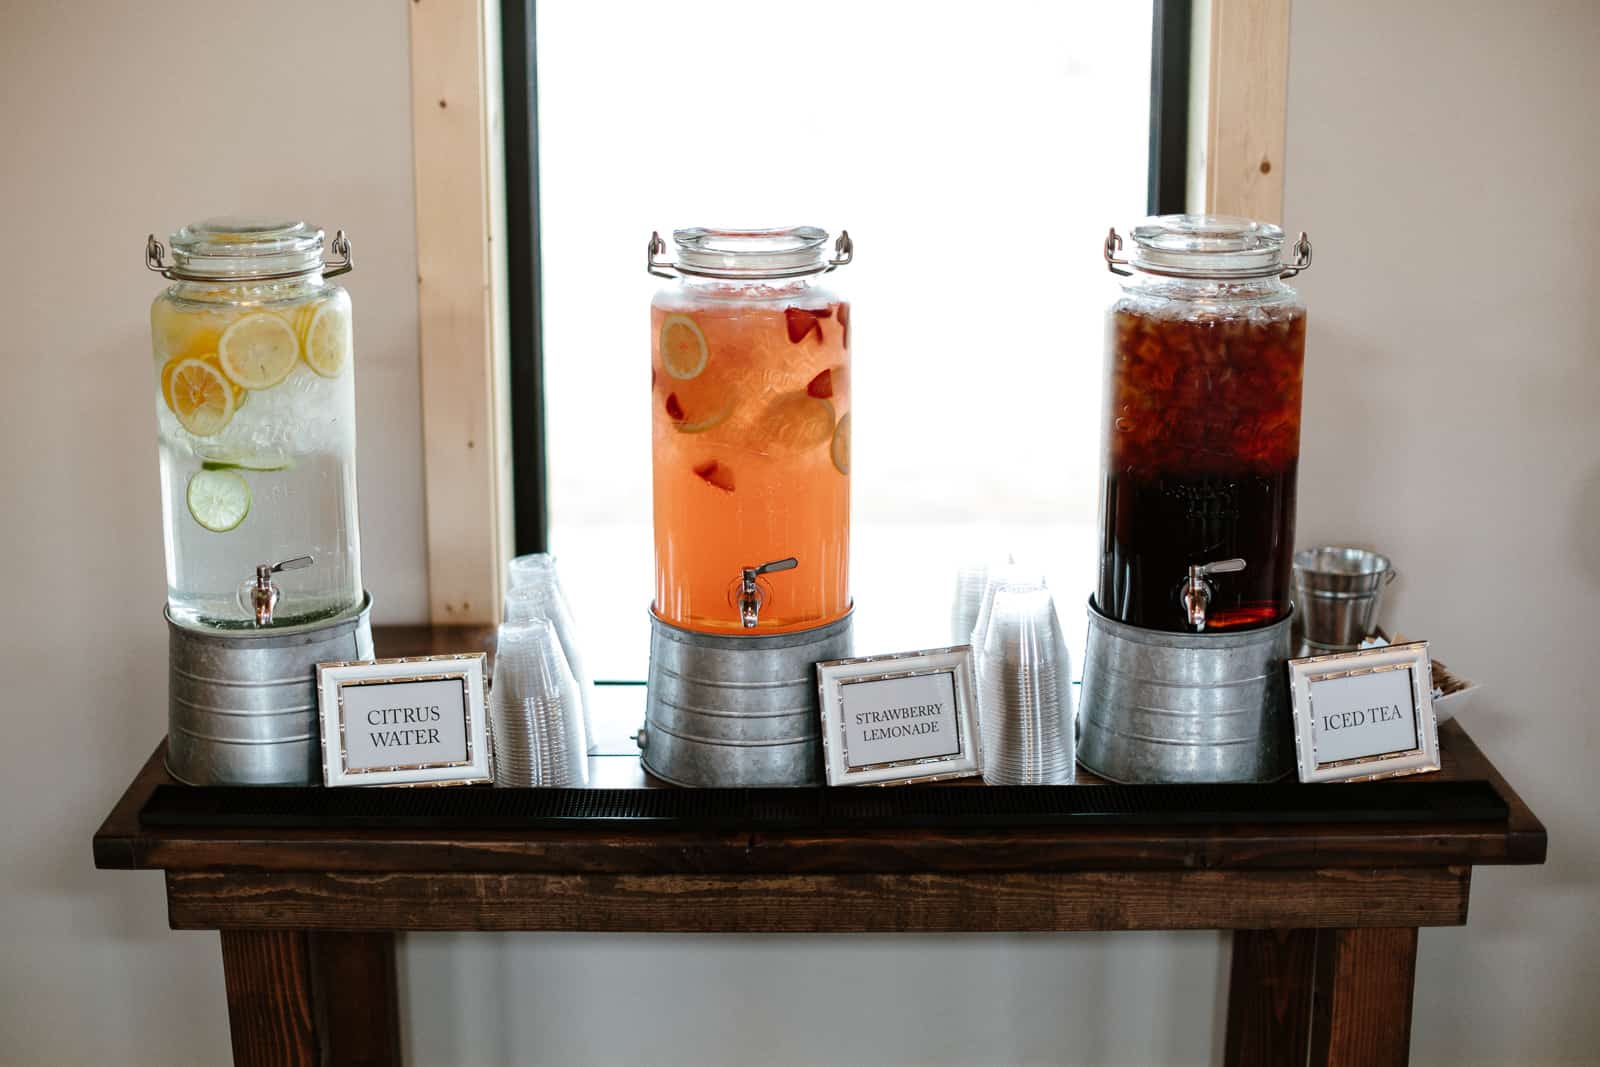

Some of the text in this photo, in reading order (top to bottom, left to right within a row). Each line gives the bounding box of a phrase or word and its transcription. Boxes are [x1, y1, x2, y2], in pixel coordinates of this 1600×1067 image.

[367, 705, 440, 725] CITRUS
[855, 703, 942, 725] STRAWBERRY
[1322, 704, 1403, 731] ICED TEA
[370, 728, 441, 747] WATER
[863, 721, 940, 741] LEMONADE
